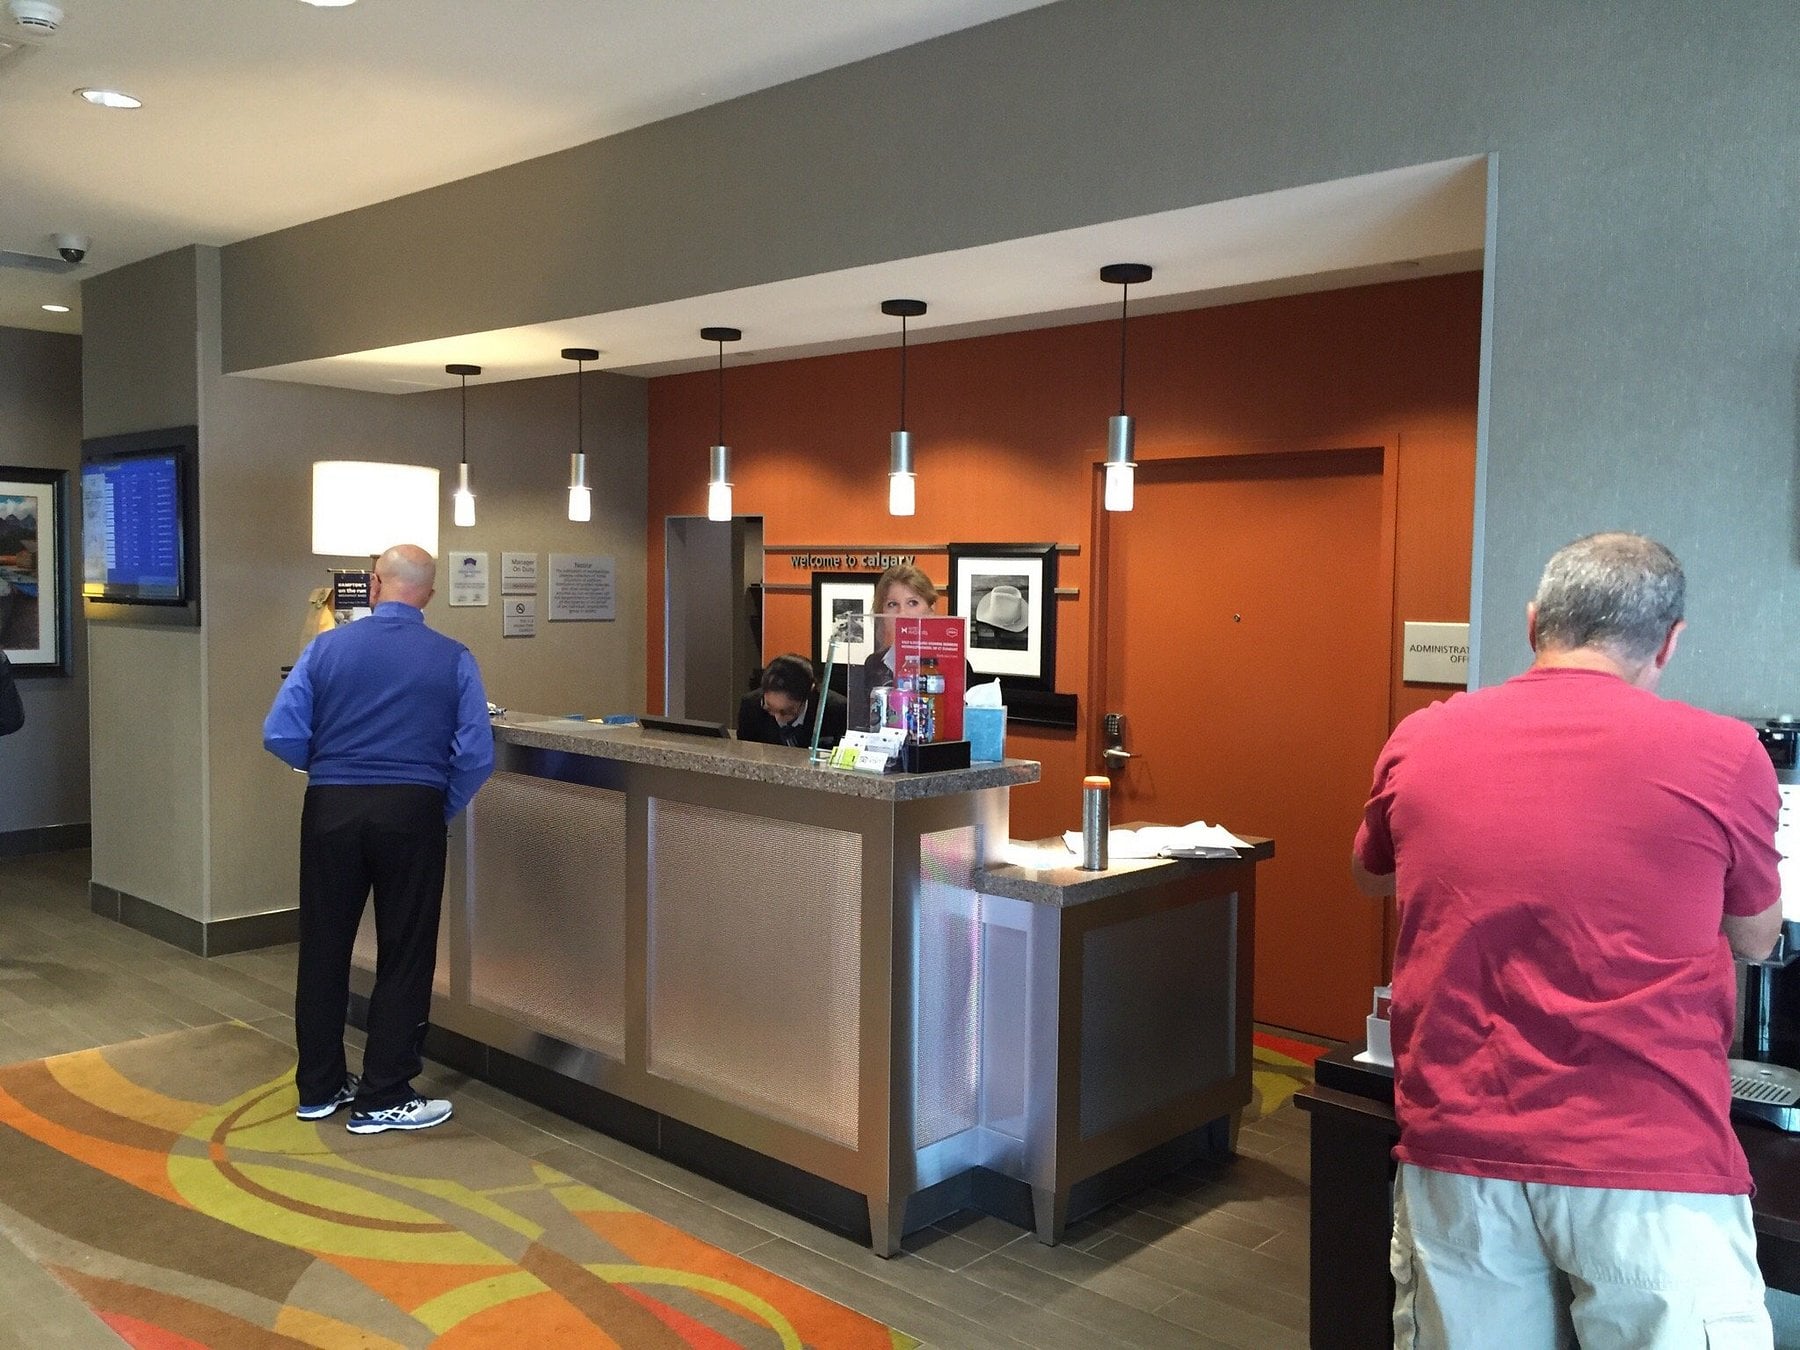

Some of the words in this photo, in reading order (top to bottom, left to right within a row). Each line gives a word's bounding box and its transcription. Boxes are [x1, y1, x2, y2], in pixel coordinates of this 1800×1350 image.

[791, 553, 841, 567] welcome
[845, 553, 857, 567] to
[861, 552, 915, 570] calgary
[1409, 644, 1470, 654] ADMINISTRAT
[1450, 655, 1468, 663] OFF
